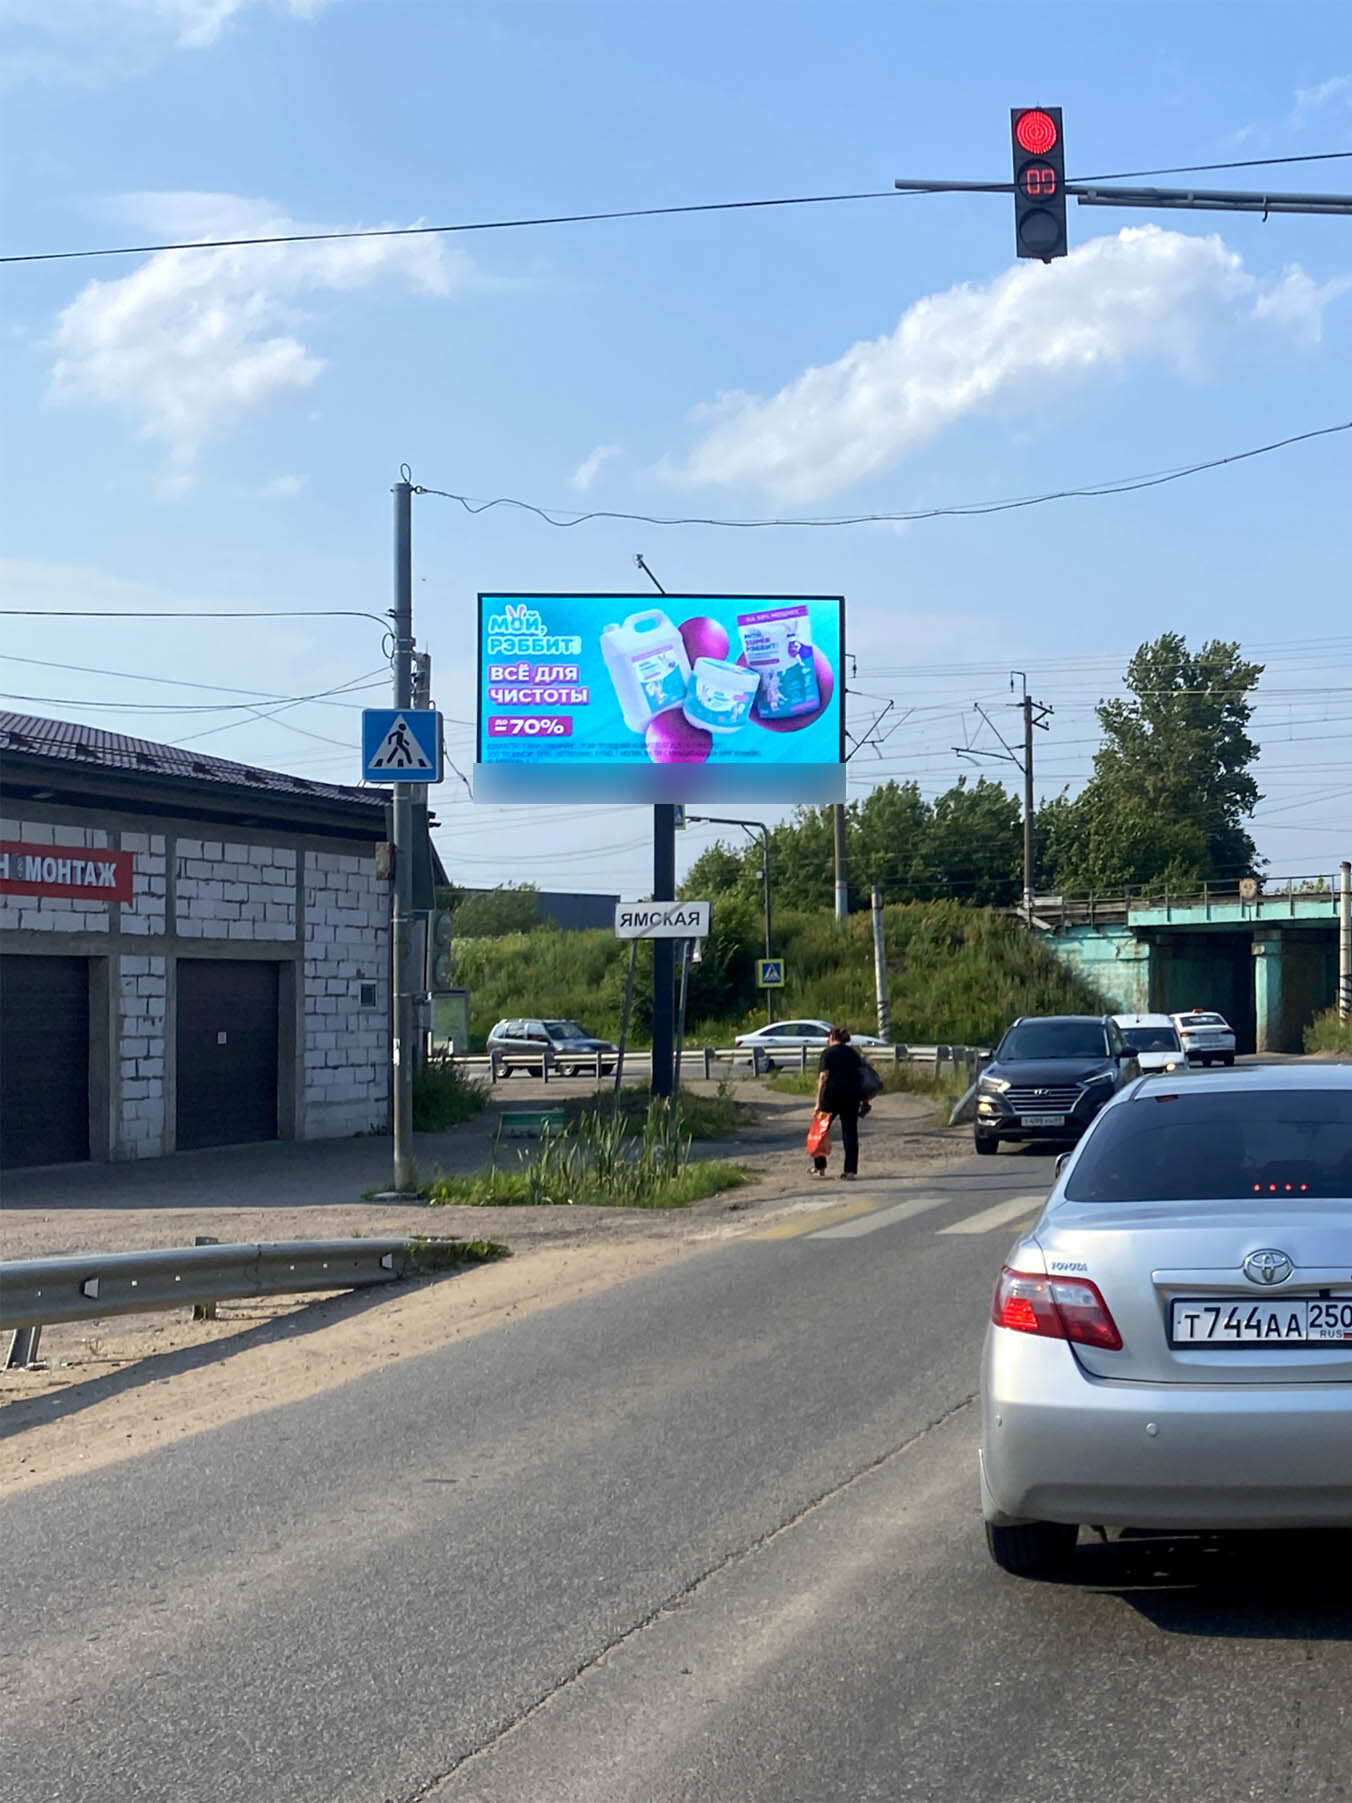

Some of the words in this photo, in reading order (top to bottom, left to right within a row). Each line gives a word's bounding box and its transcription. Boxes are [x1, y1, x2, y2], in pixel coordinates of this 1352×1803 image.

[490, 664, 530, 681] ВСЁ
[535, 666, 578, 682] ДЛЯ
[490, 689, 588, 703] ЧИСТОТЫ
[25, 855, 117, 888] МОНТАЖ
[620, 911, 701, 928] ЯМСКАЯ
[1319, 1329, 1343, 1339] RUS
